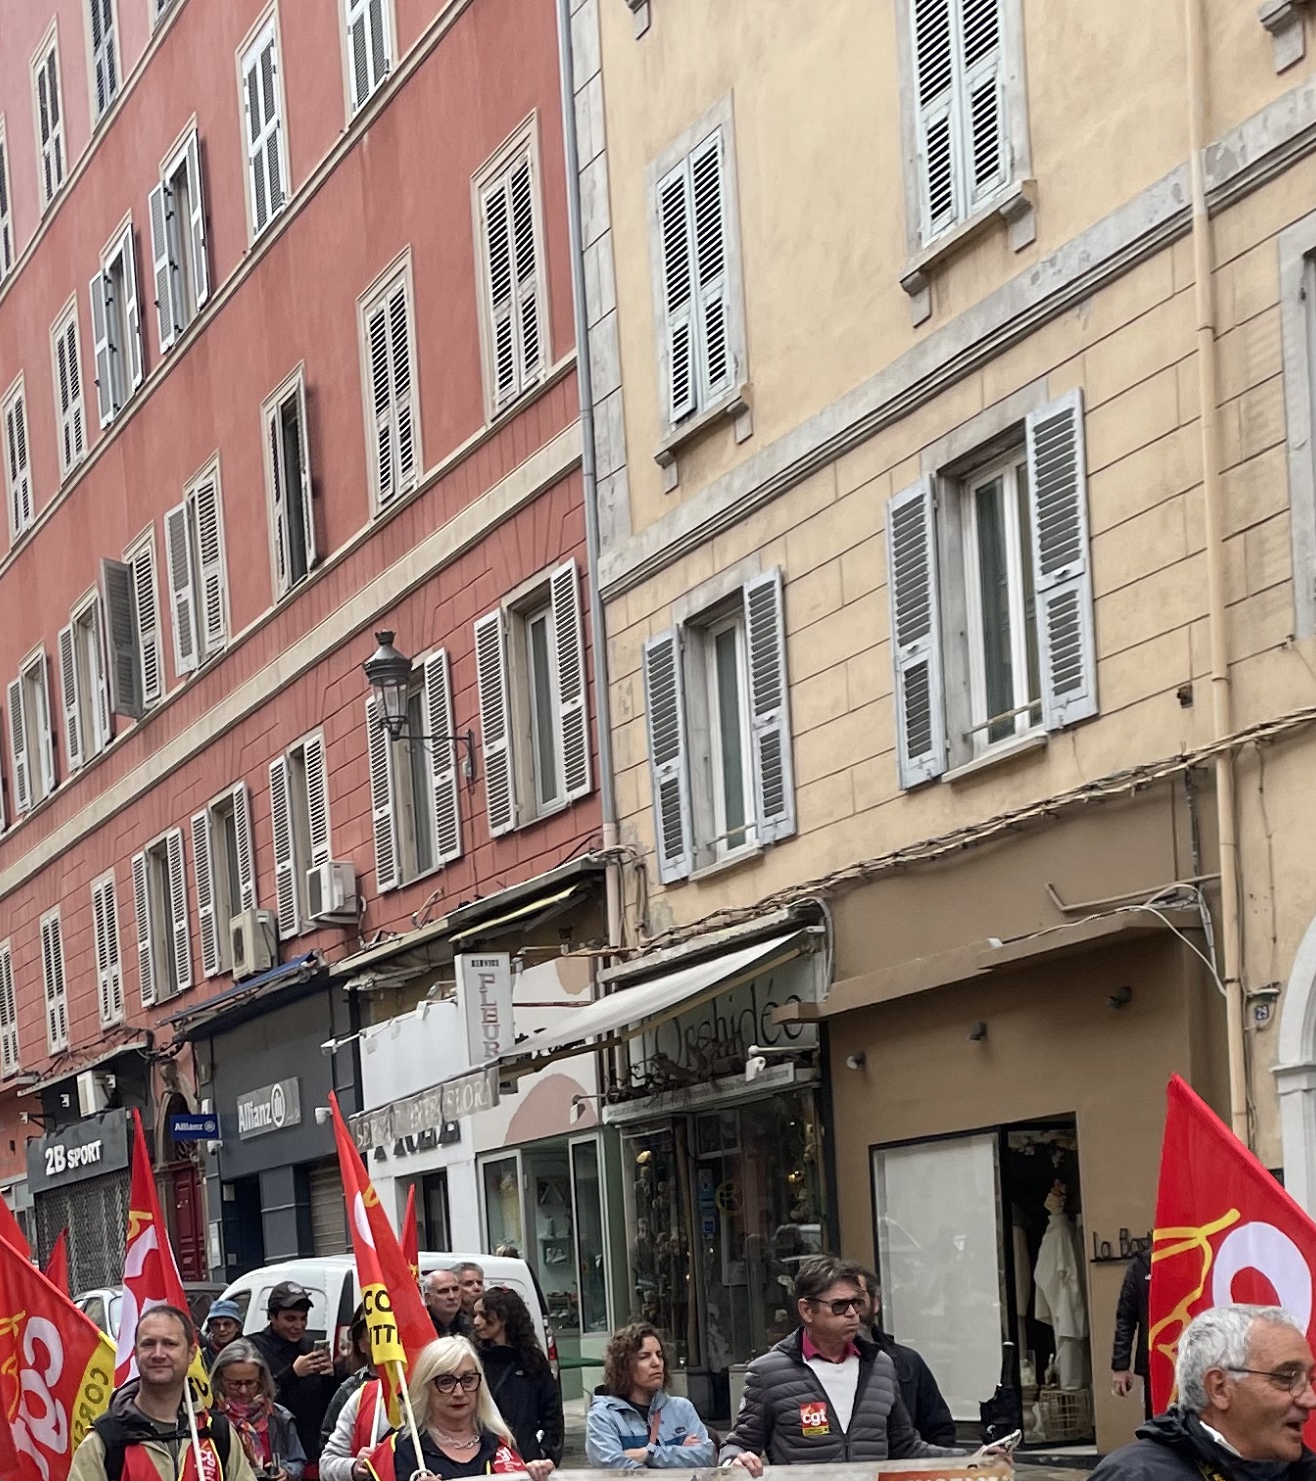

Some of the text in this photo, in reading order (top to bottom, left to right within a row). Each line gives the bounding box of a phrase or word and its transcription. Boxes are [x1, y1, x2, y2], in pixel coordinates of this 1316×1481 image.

[174, 1121, 203, 1132] Allianz
[238, 1100, 273, 1133] Allianz
[45, 1139, 102, 1176] 2B SPORT
[801, 1409, 828, 1427] cgt
